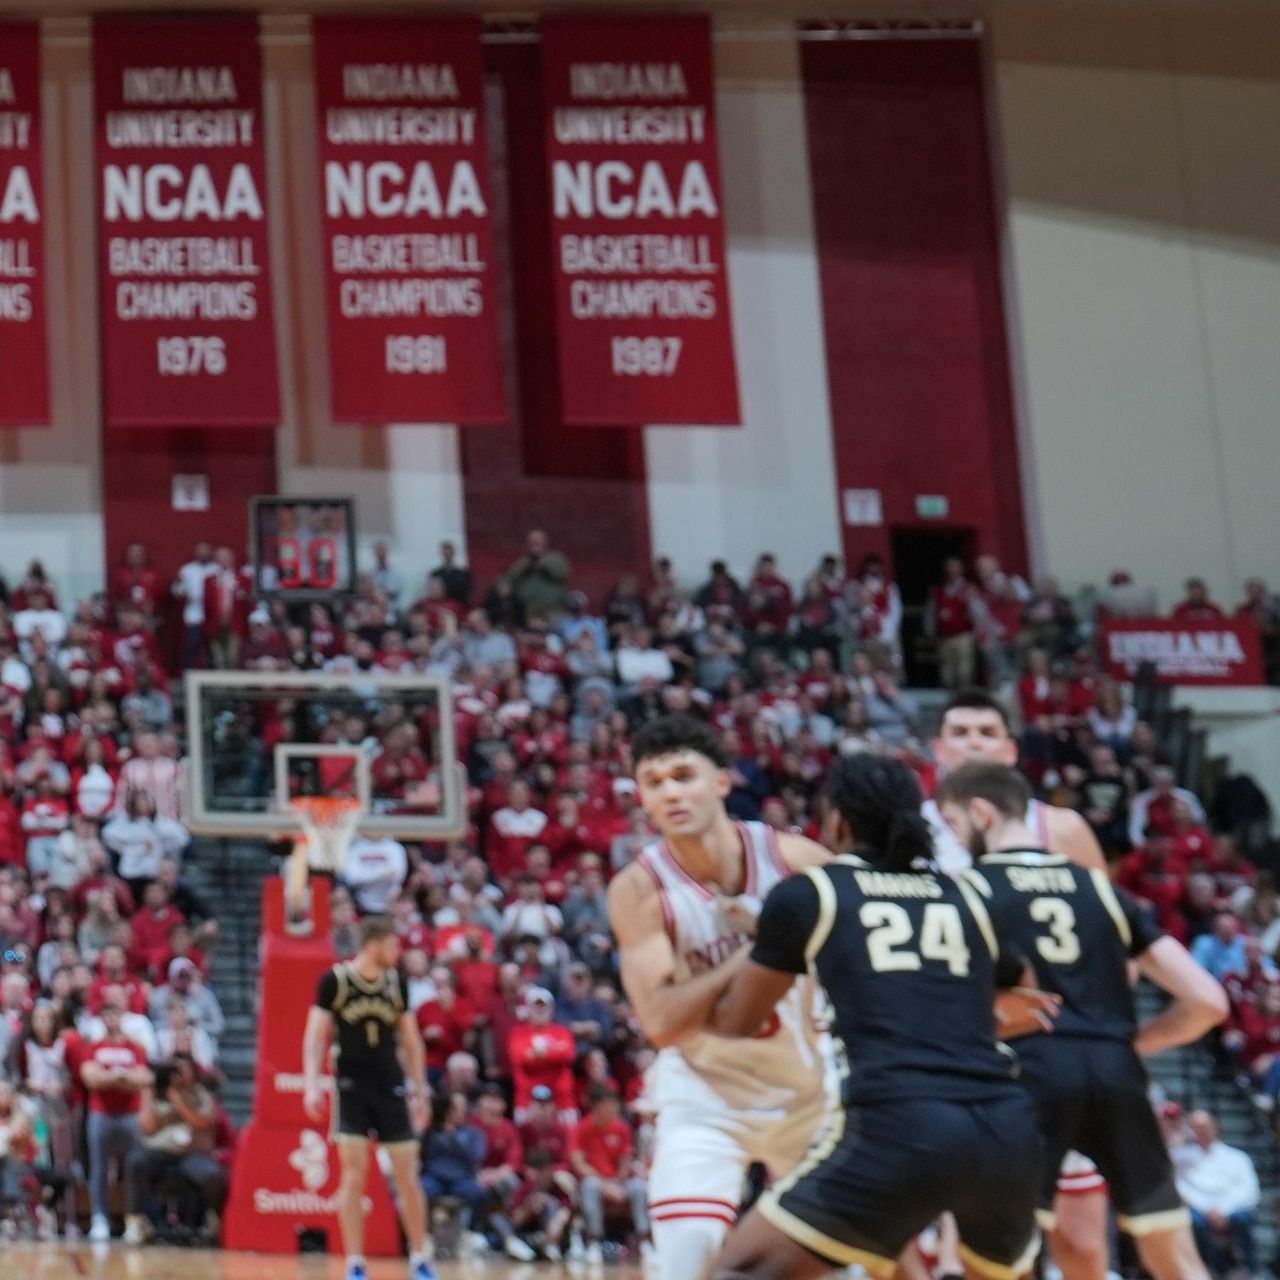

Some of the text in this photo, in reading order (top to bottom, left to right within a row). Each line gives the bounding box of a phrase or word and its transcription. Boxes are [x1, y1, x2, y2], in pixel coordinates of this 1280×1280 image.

[123, 67, 237, 102] INDIANA
[343, 64, 459, 99] INDIANA
[569, 63, 686, 98] INDIANA
[106, 110, 255, 147] UNIVERSITY
[326, 107, 476, 144] UNIVERSITY
[553, 107, 705, 144] UNIVERSITY
[104, 163, 263, 219] NCAA
[324, 161, 487, 218] NCAA
[552, 160, 718, 218] NCAA
[108, 237, 260, 275] BASKETBALL
[332, 234, 485, 273] BASKETBALL
[561, 235, 717, 274] BASKETBALL
[117, 281, 257, 320] CHAMPIONS
[340, 279, 483, 318] CHAMPIONS
[571, 280, 715, 318] CHAMPIONS
[157, 337, 226, 375] 1976
[611, 337, 683, 376] 1987
[1109, 630, 1246, 663] INDIANA
[1005, 867, 1078, 894] SMITH
[859, 901, 970, 977] 24
[1029, 897, 1080, 964] 3
